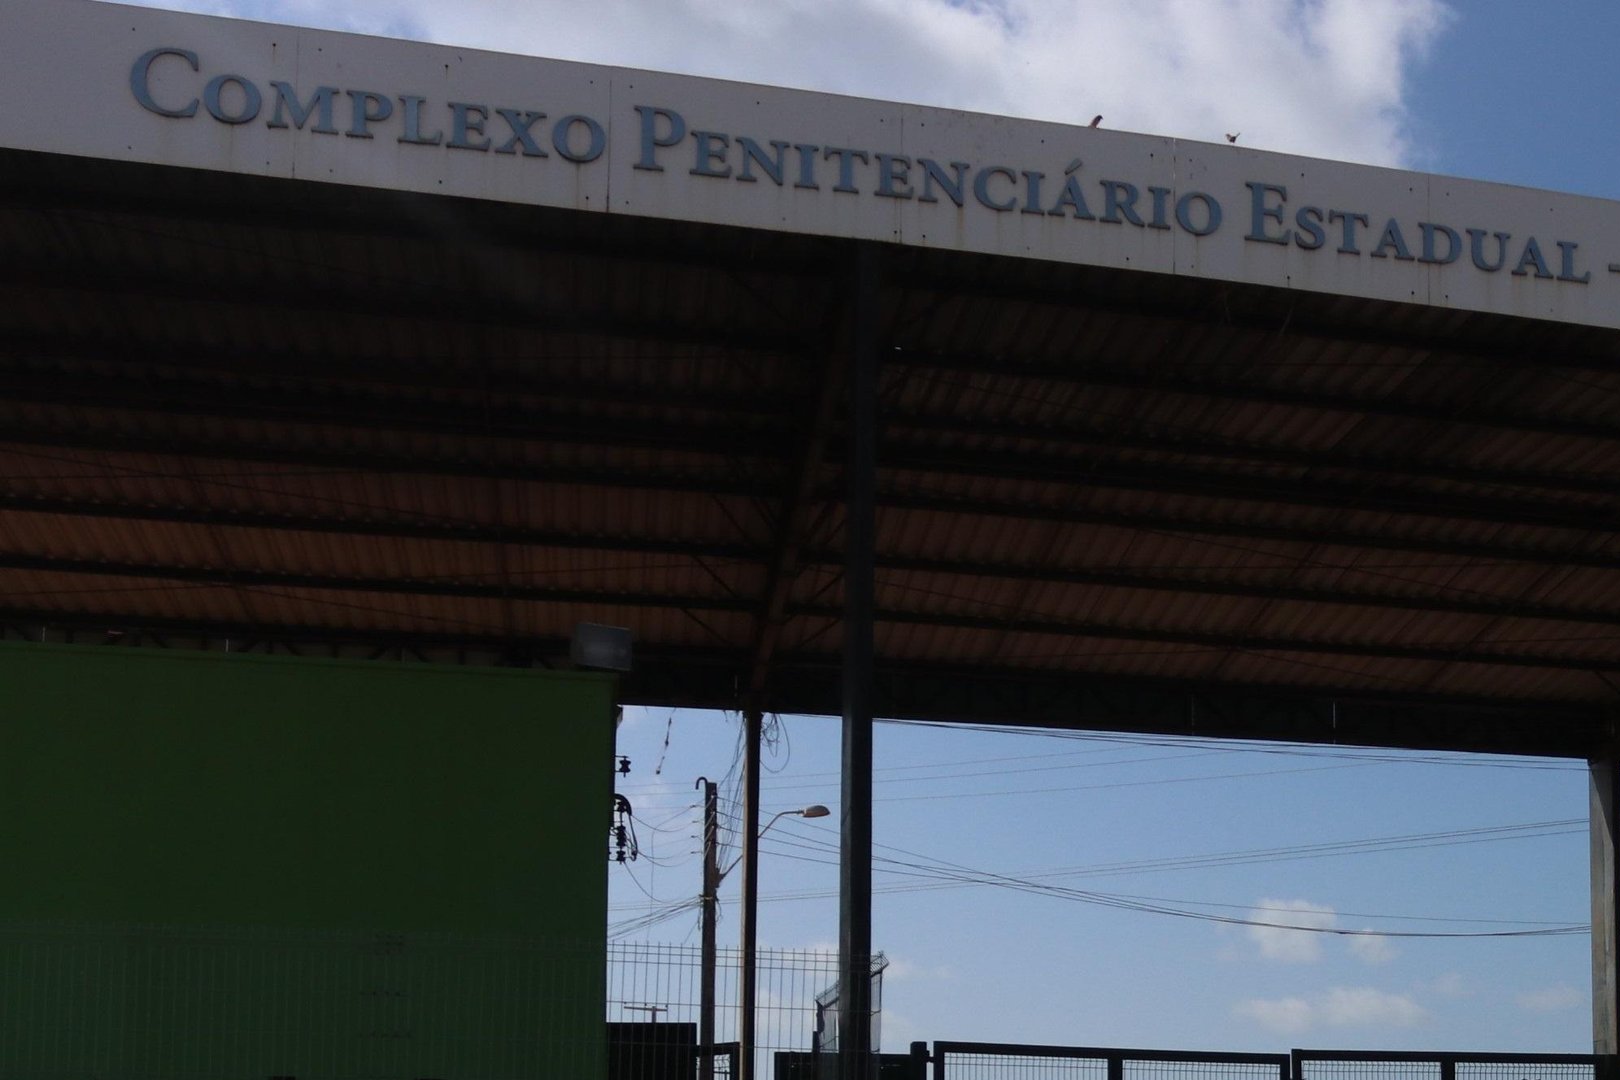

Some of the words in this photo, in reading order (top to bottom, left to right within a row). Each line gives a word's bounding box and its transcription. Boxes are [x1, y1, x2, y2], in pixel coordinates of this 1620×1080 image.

[129, 45, 607, 165] COMPLEXO
[631, 105, 1223, 237] PENITENCIÁRIO
[1244, 180, 1591, 284] ESTADUAL
